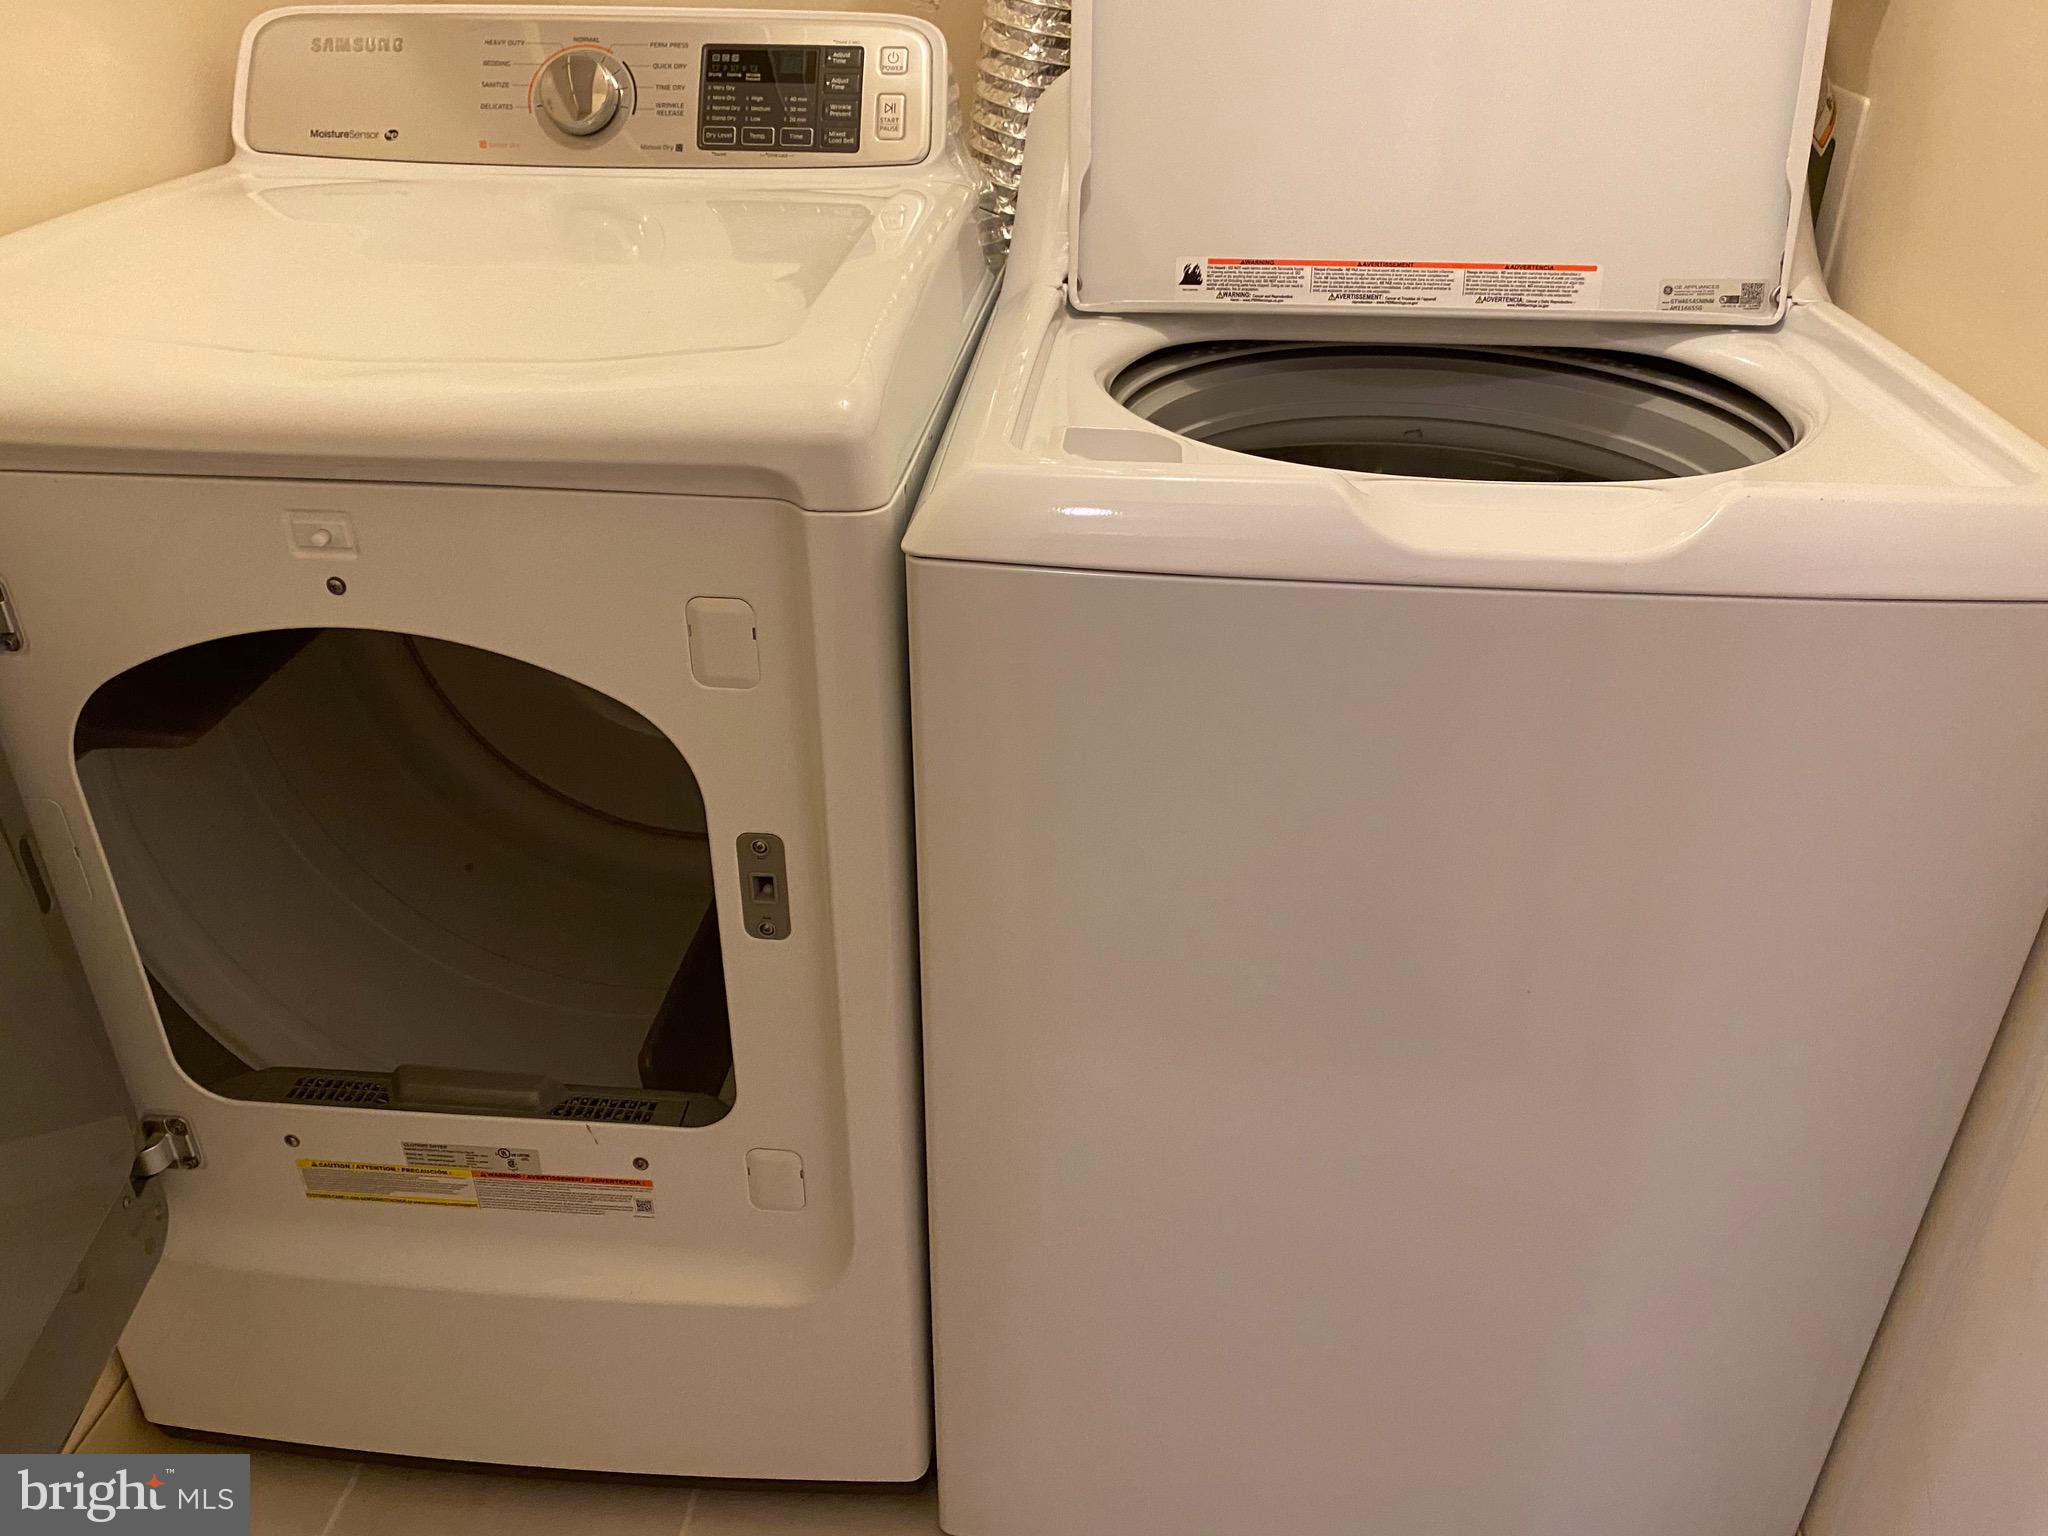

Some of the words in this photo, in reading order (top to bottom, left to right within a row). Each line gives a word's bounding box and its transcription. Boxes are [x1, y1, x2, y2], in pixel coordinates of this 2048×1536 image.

[310, 37, 404, 53] SAMSUNG
[649, 41, 668, 49] PERM
[669, 41, 689, 49] PRESS
[832, 51, 851, 60] Adjust
[652, 62, 672, 70] QUICK
[831, 78, 849, 86] Adjust
[310, 129, 380, 139] MoistureSensor
[705, 131, 717, 139] Dry
[640, 143, 662, 151] Manual
[662, 144, 675, 153] Dry
[1223, 291, 1252, 299] WARNING:
[317, 1162, 351, 1170] CAUTION
[355, 1163, 397, 1172] ATTENTION
